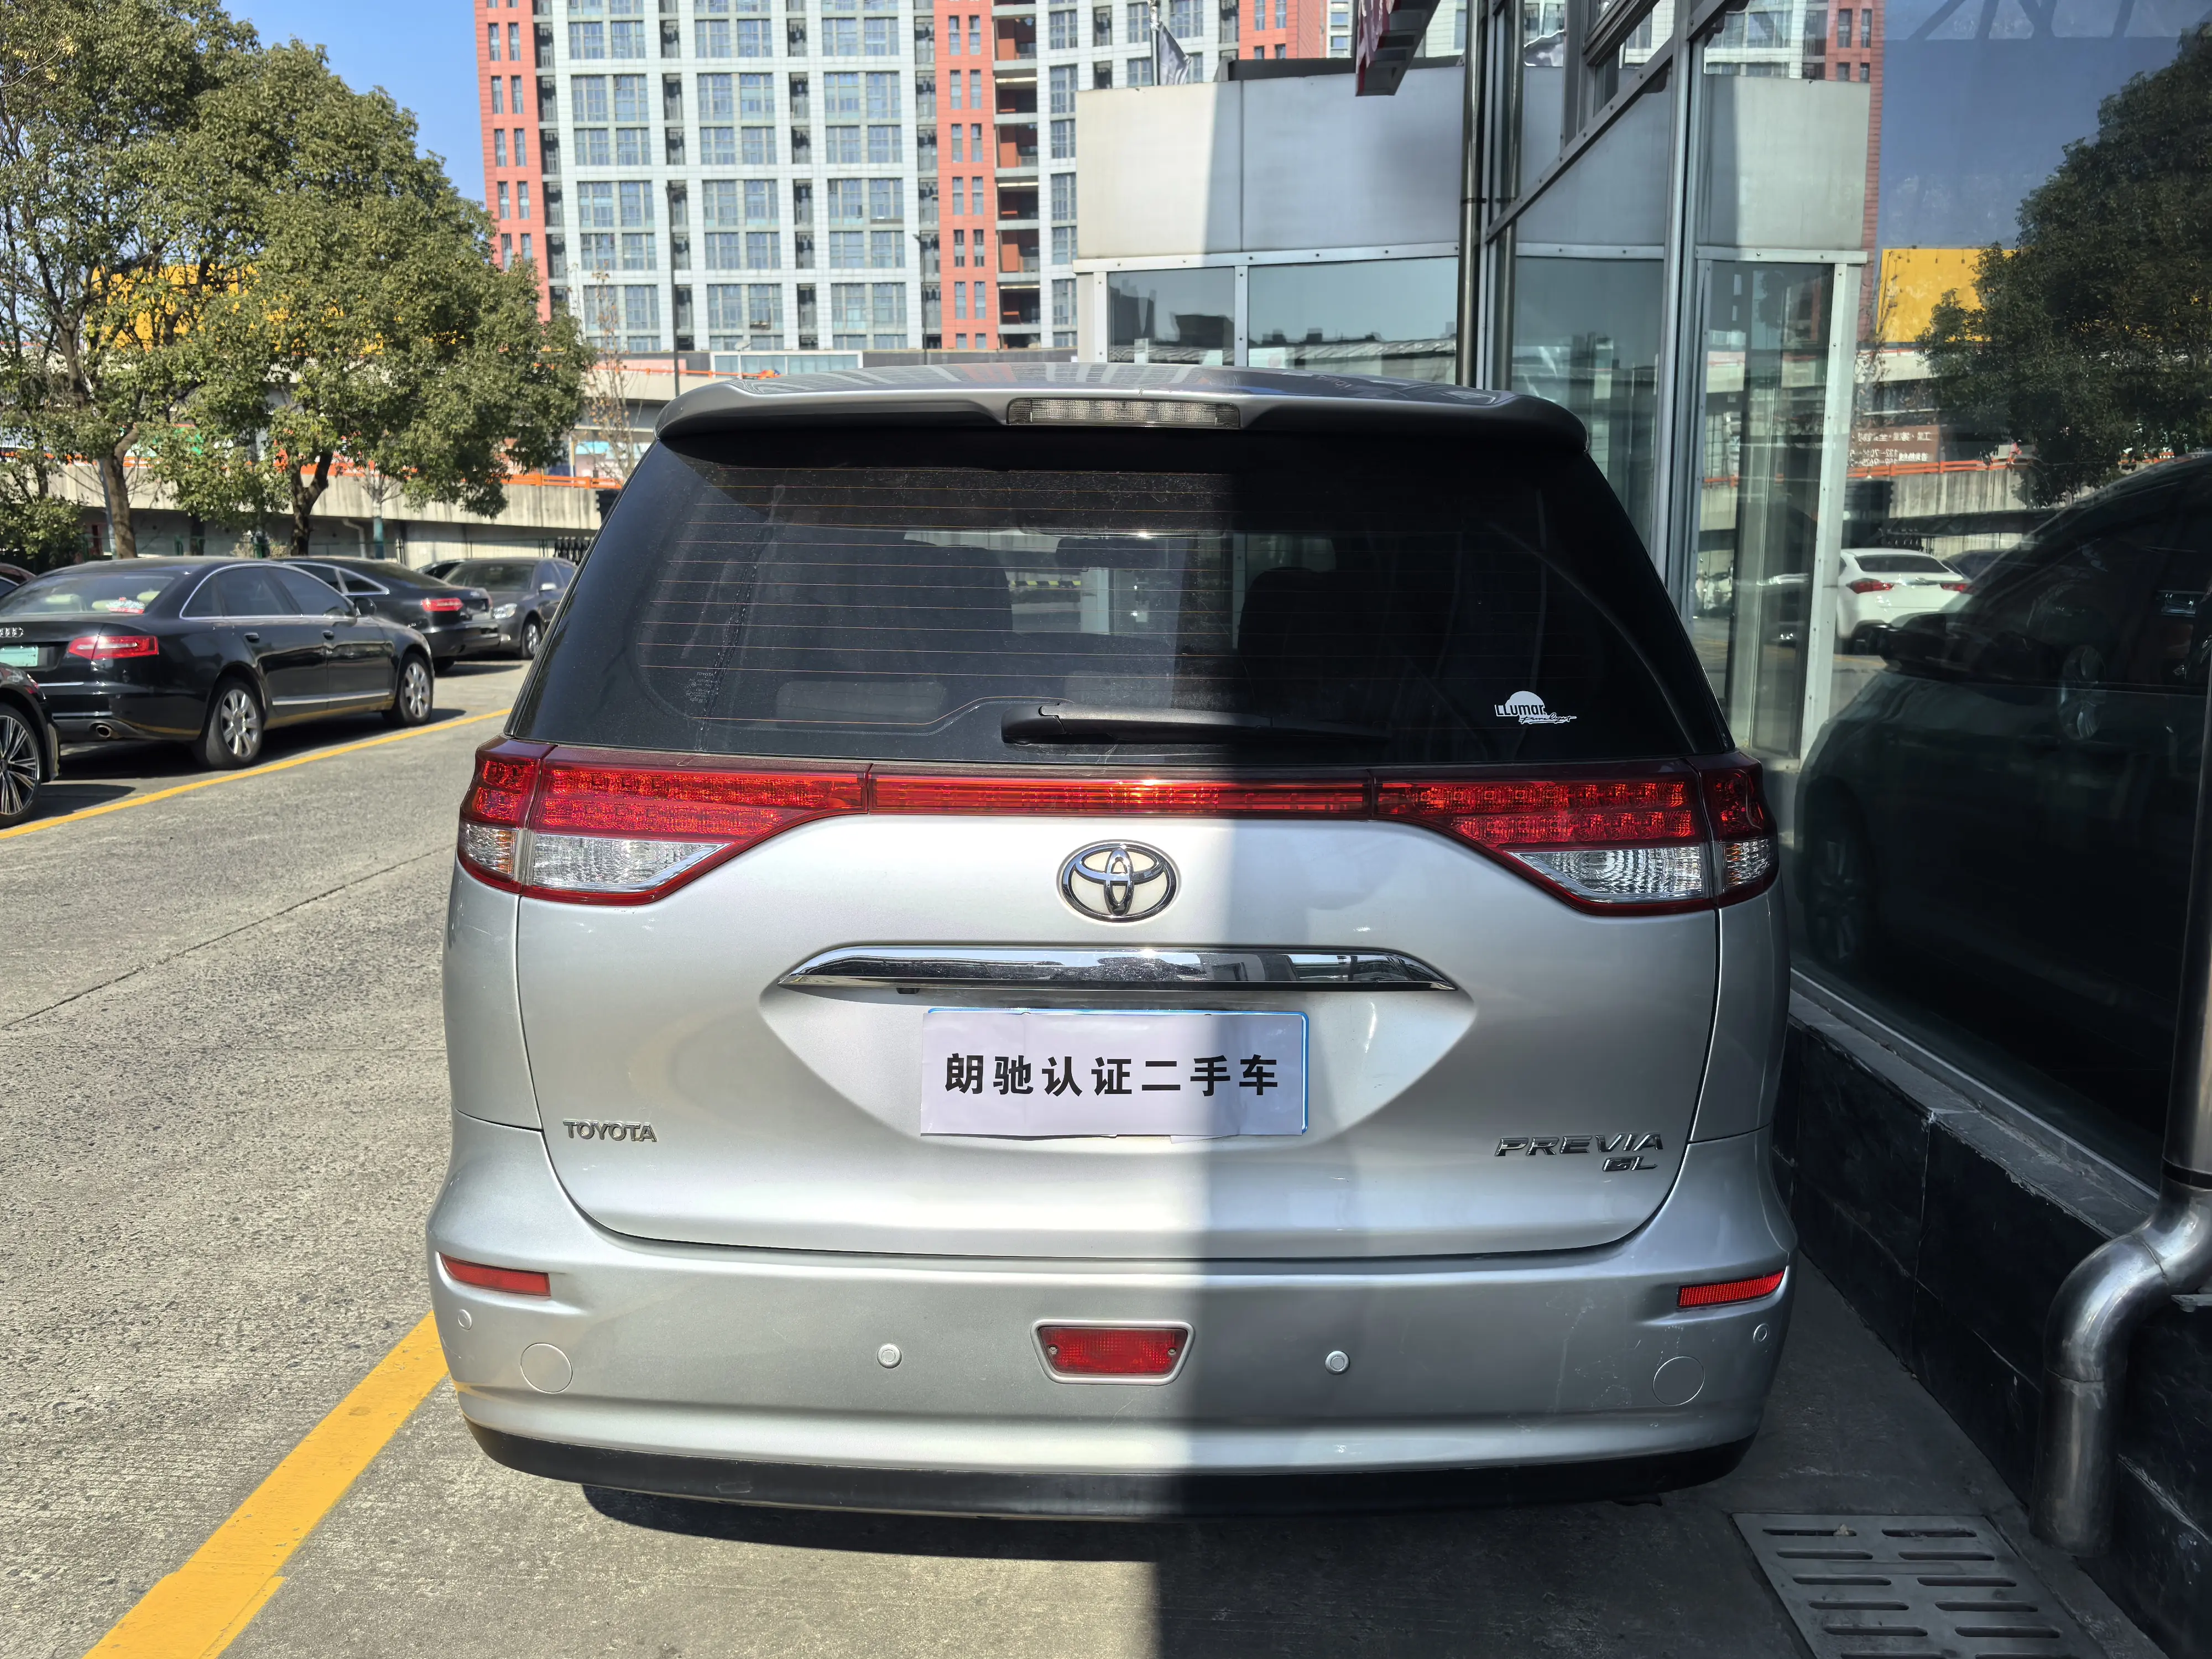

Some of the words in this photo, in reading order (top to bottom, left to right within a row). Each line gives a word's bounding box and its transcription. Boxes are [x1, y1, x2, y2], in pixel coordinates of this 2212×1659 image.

[945, 1053, 1279, 1097] 朗驰认证二手车
[562, 1119, 658, 1142] TOYOTA
[1494, 1133, 1663, 1156] PREVIA
[1603, 1156, 1658, 1172] GL
